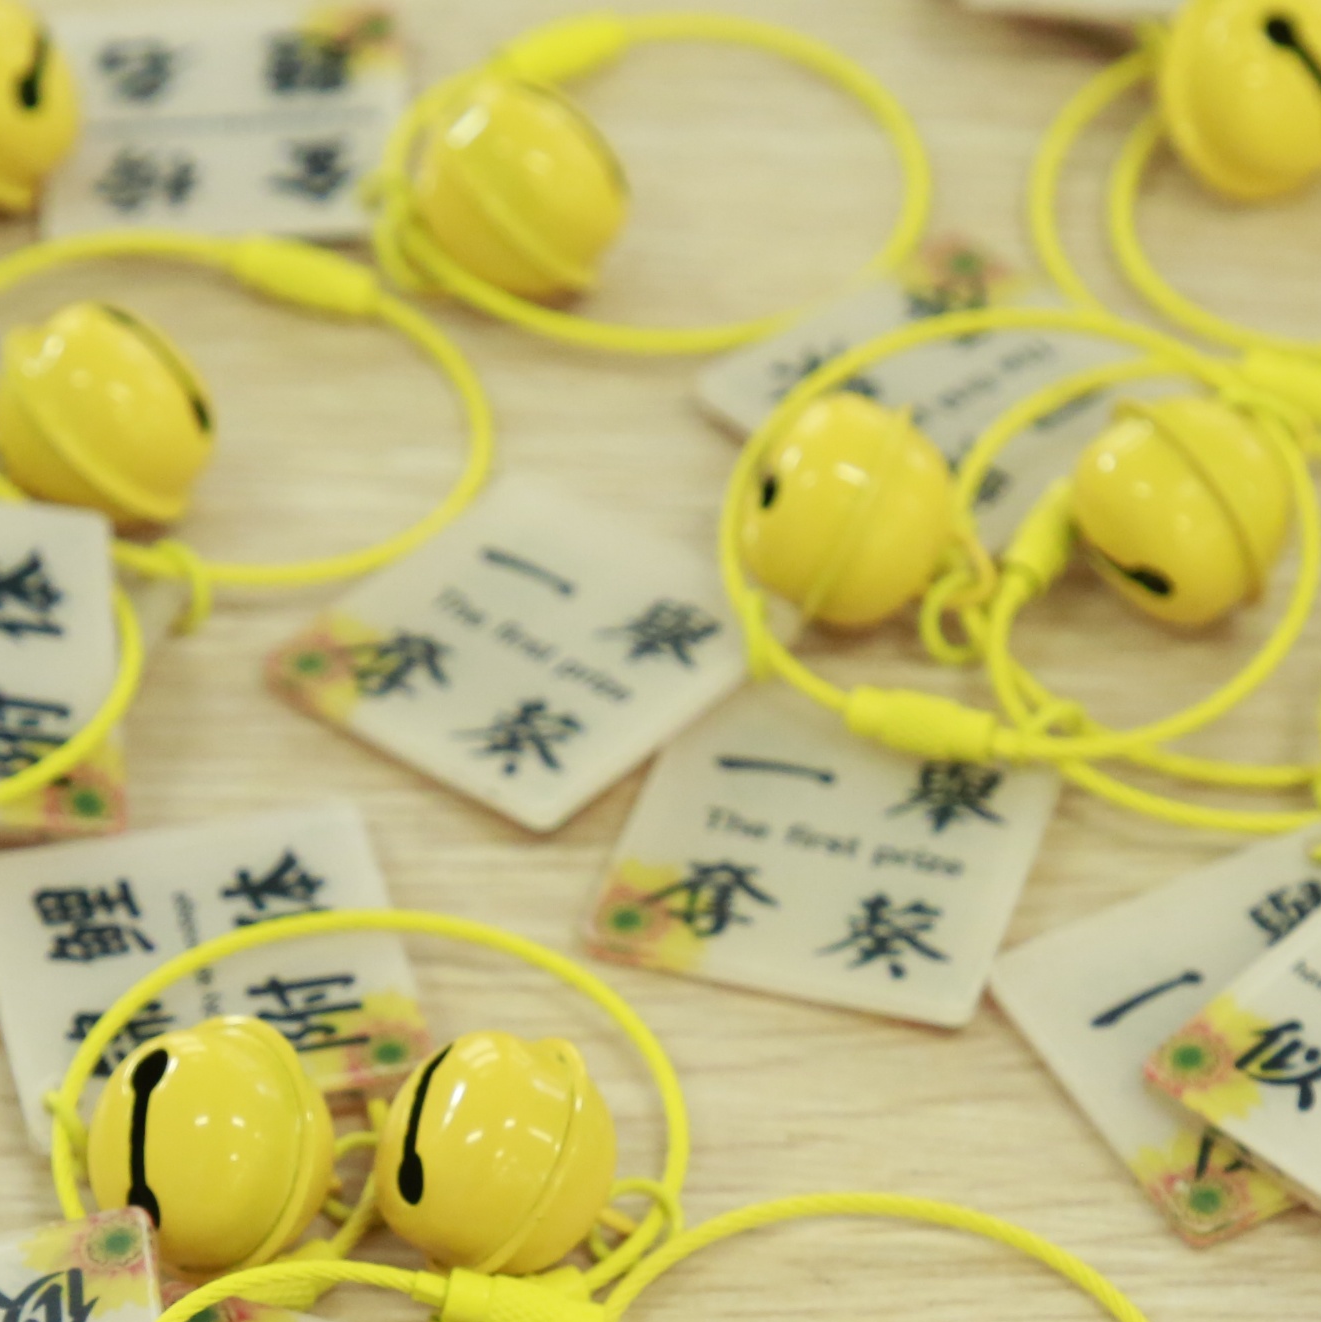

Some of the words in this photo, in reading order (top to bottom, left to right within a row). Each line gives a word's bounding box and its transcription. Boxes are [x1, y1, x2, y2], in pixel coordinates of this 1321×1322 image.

[705, 805, 770, 844] The
[785, 822, 861, 862] first
[871, 836, 964, 880] prize
